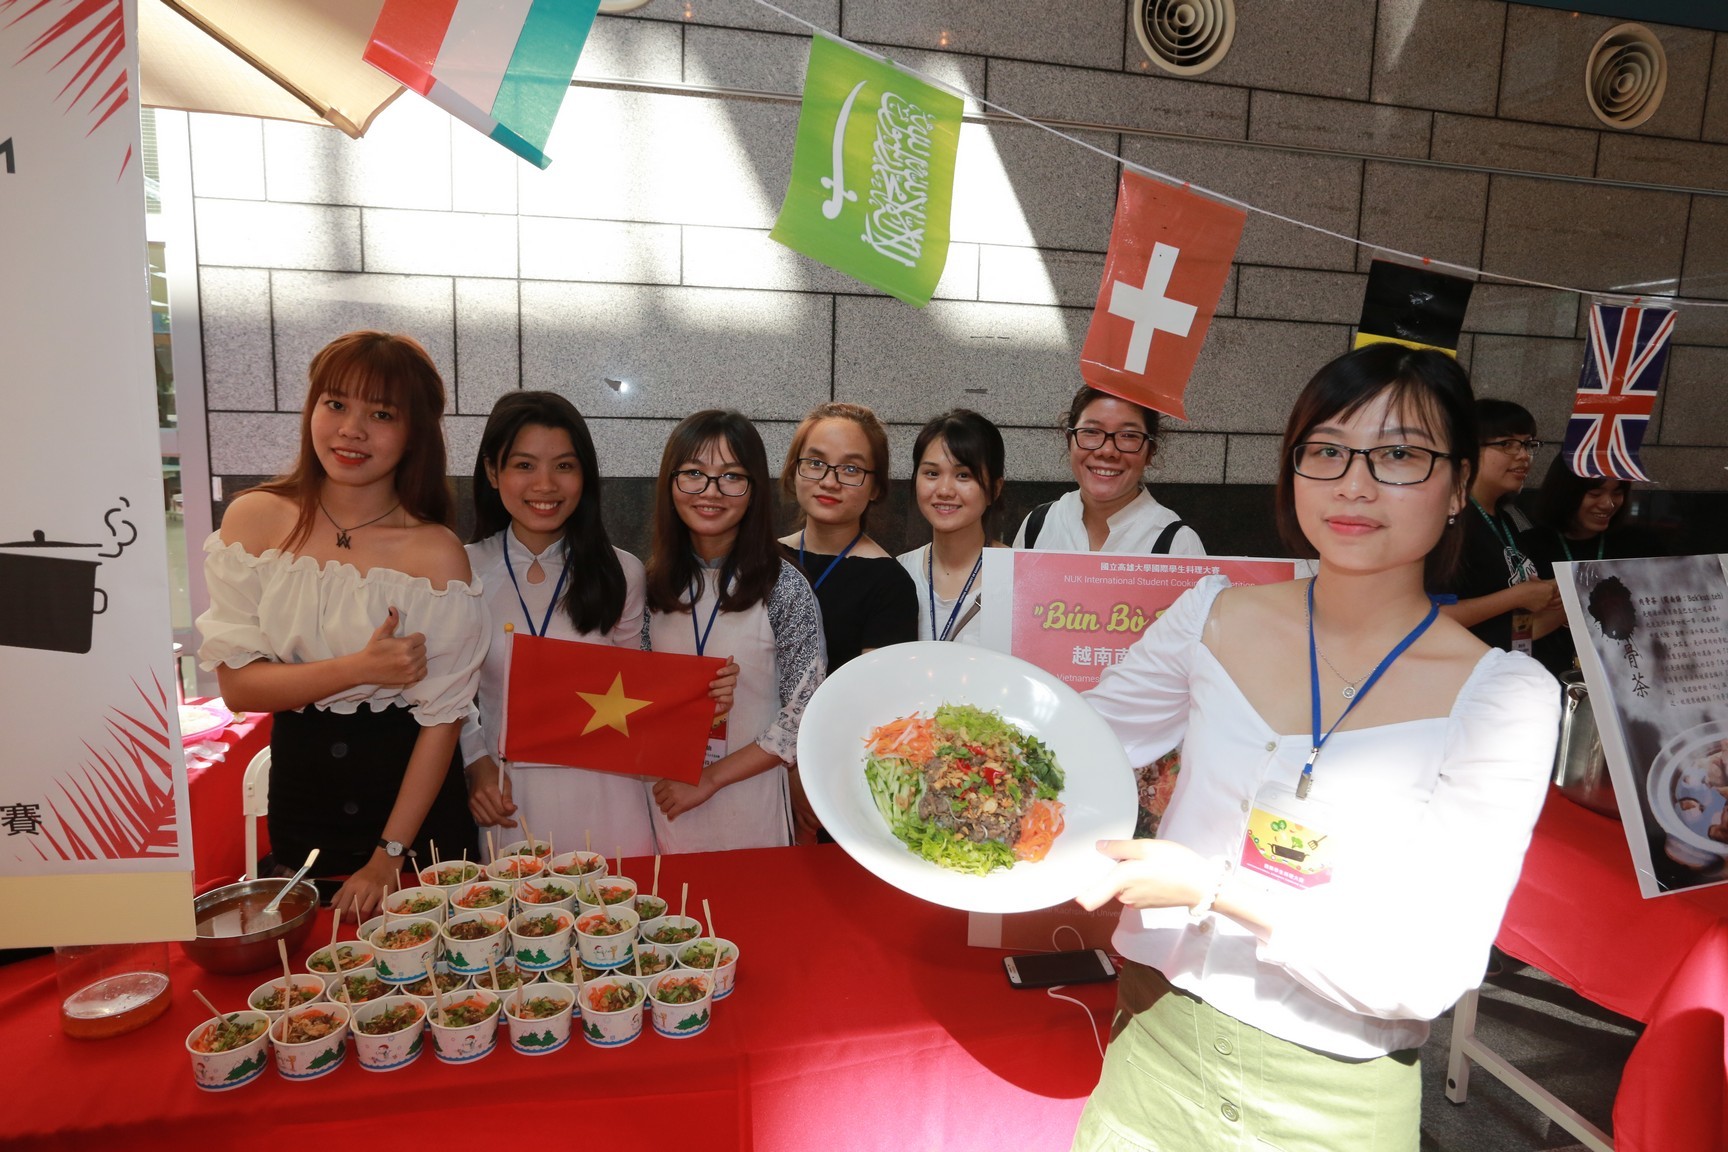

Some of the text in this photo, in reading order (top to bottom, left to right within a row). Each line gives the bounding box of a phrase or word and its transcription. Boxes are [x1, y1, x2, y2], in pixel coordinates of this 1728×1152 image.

[1064, 575, 1083, 584] NUK
[1084, 576, 1135, 586] International
[1137, 577, 1169, 587] Student
[1170, 578, 1197, 588] Cookin
[1106, 604, 1149, 632] Bò
[1056, 673, 1101, 684] Vietnames
[0, 803, 42, 836] 賽
